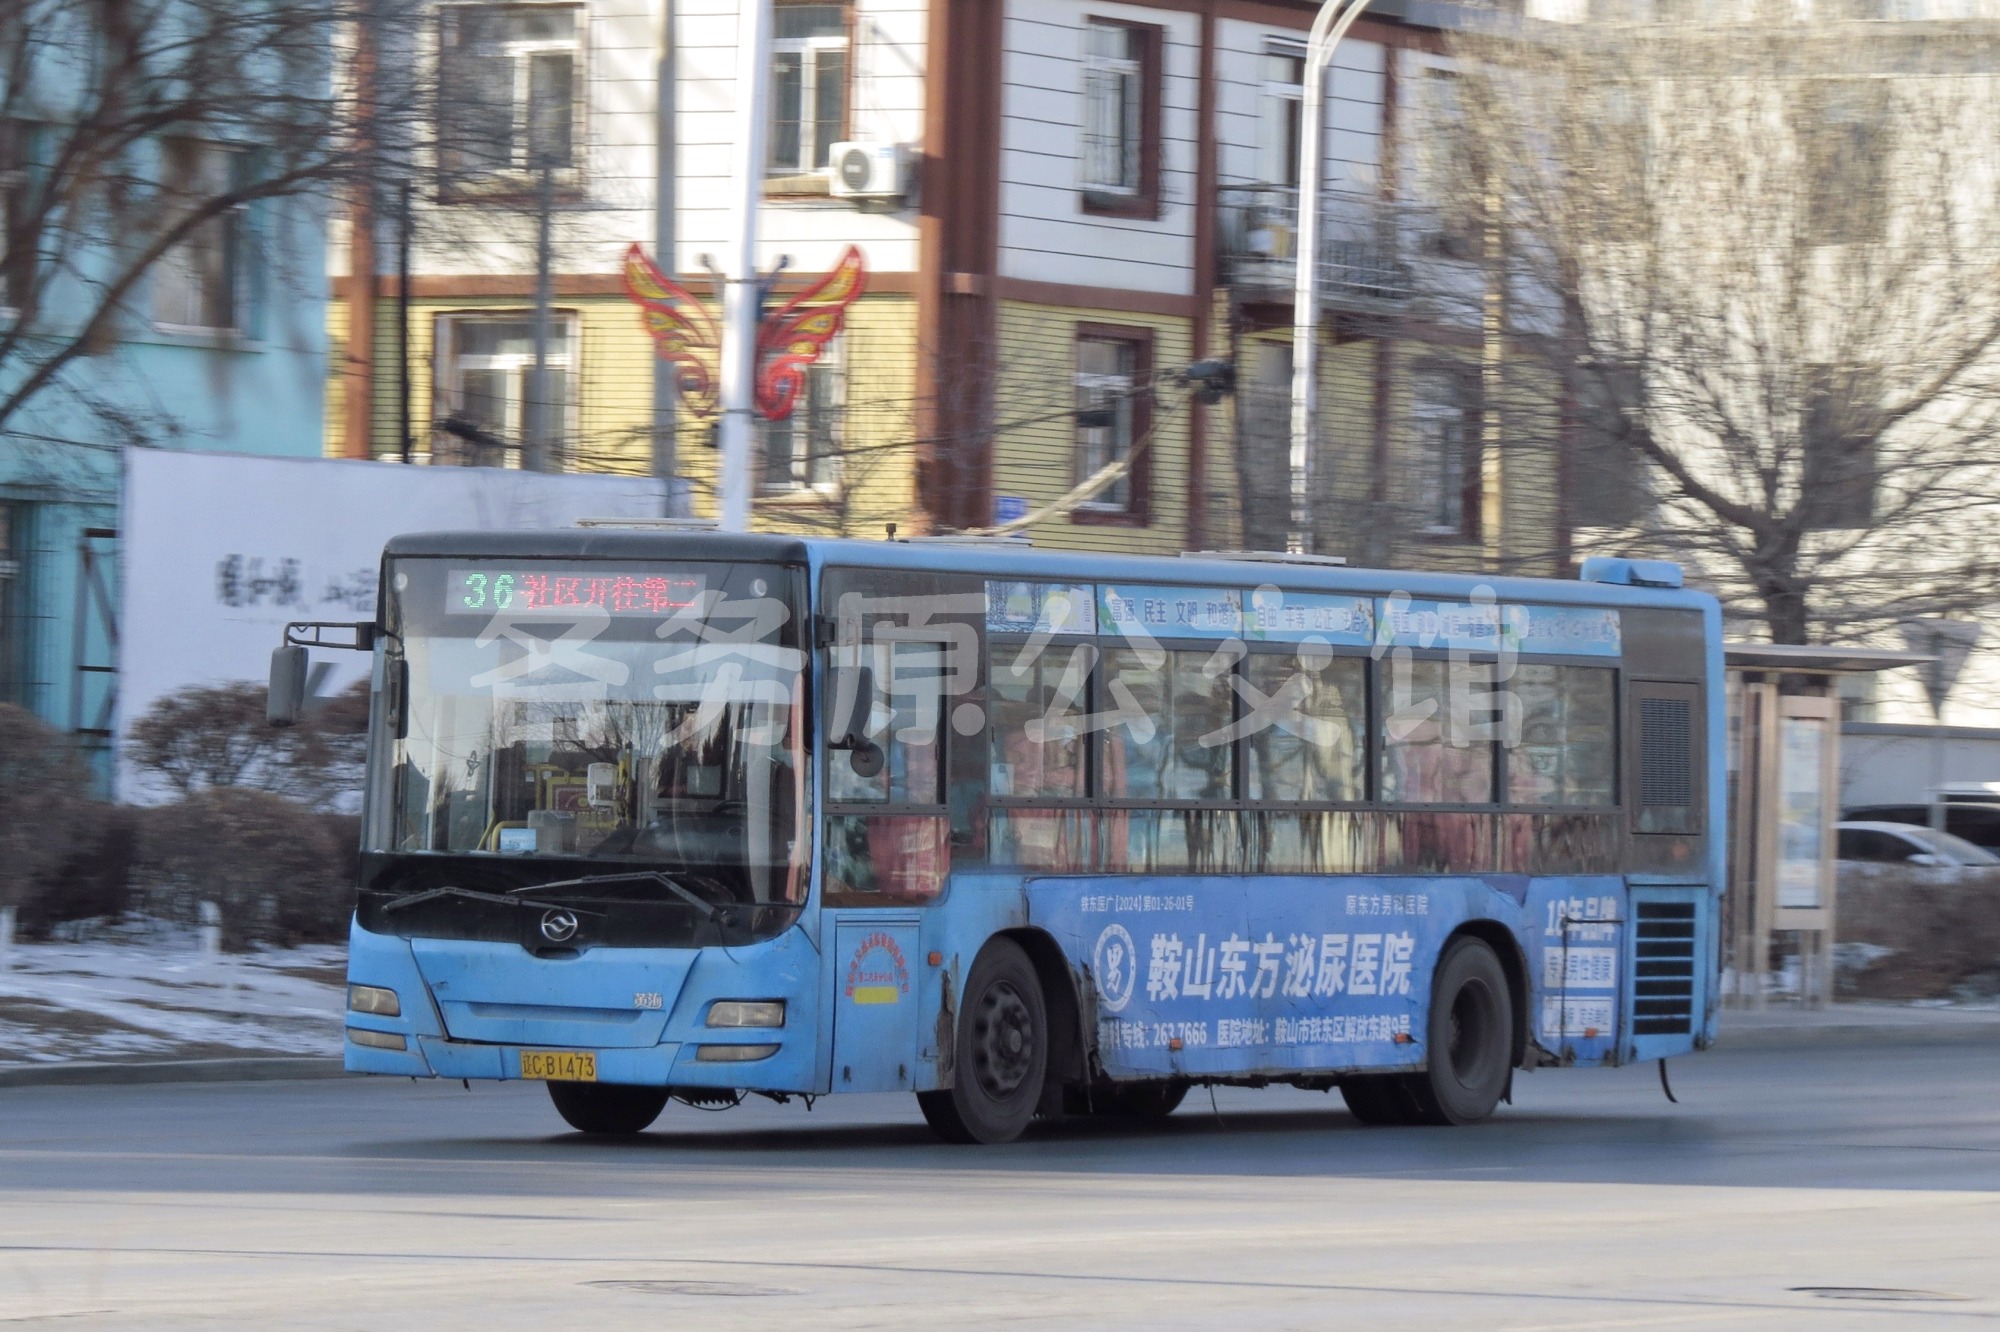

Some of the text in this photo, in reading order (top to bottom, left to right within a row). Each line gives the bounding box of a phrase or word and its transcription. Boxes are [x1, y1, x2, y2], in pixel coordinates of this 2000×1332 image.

[464, 573, 515, 608] 36
[1144, 600, 1167, 623] 民主
[1175, 600, 1198, 624] 文明
[1146, 931, 1415, 1001] 鞍山东方泌尿医院
